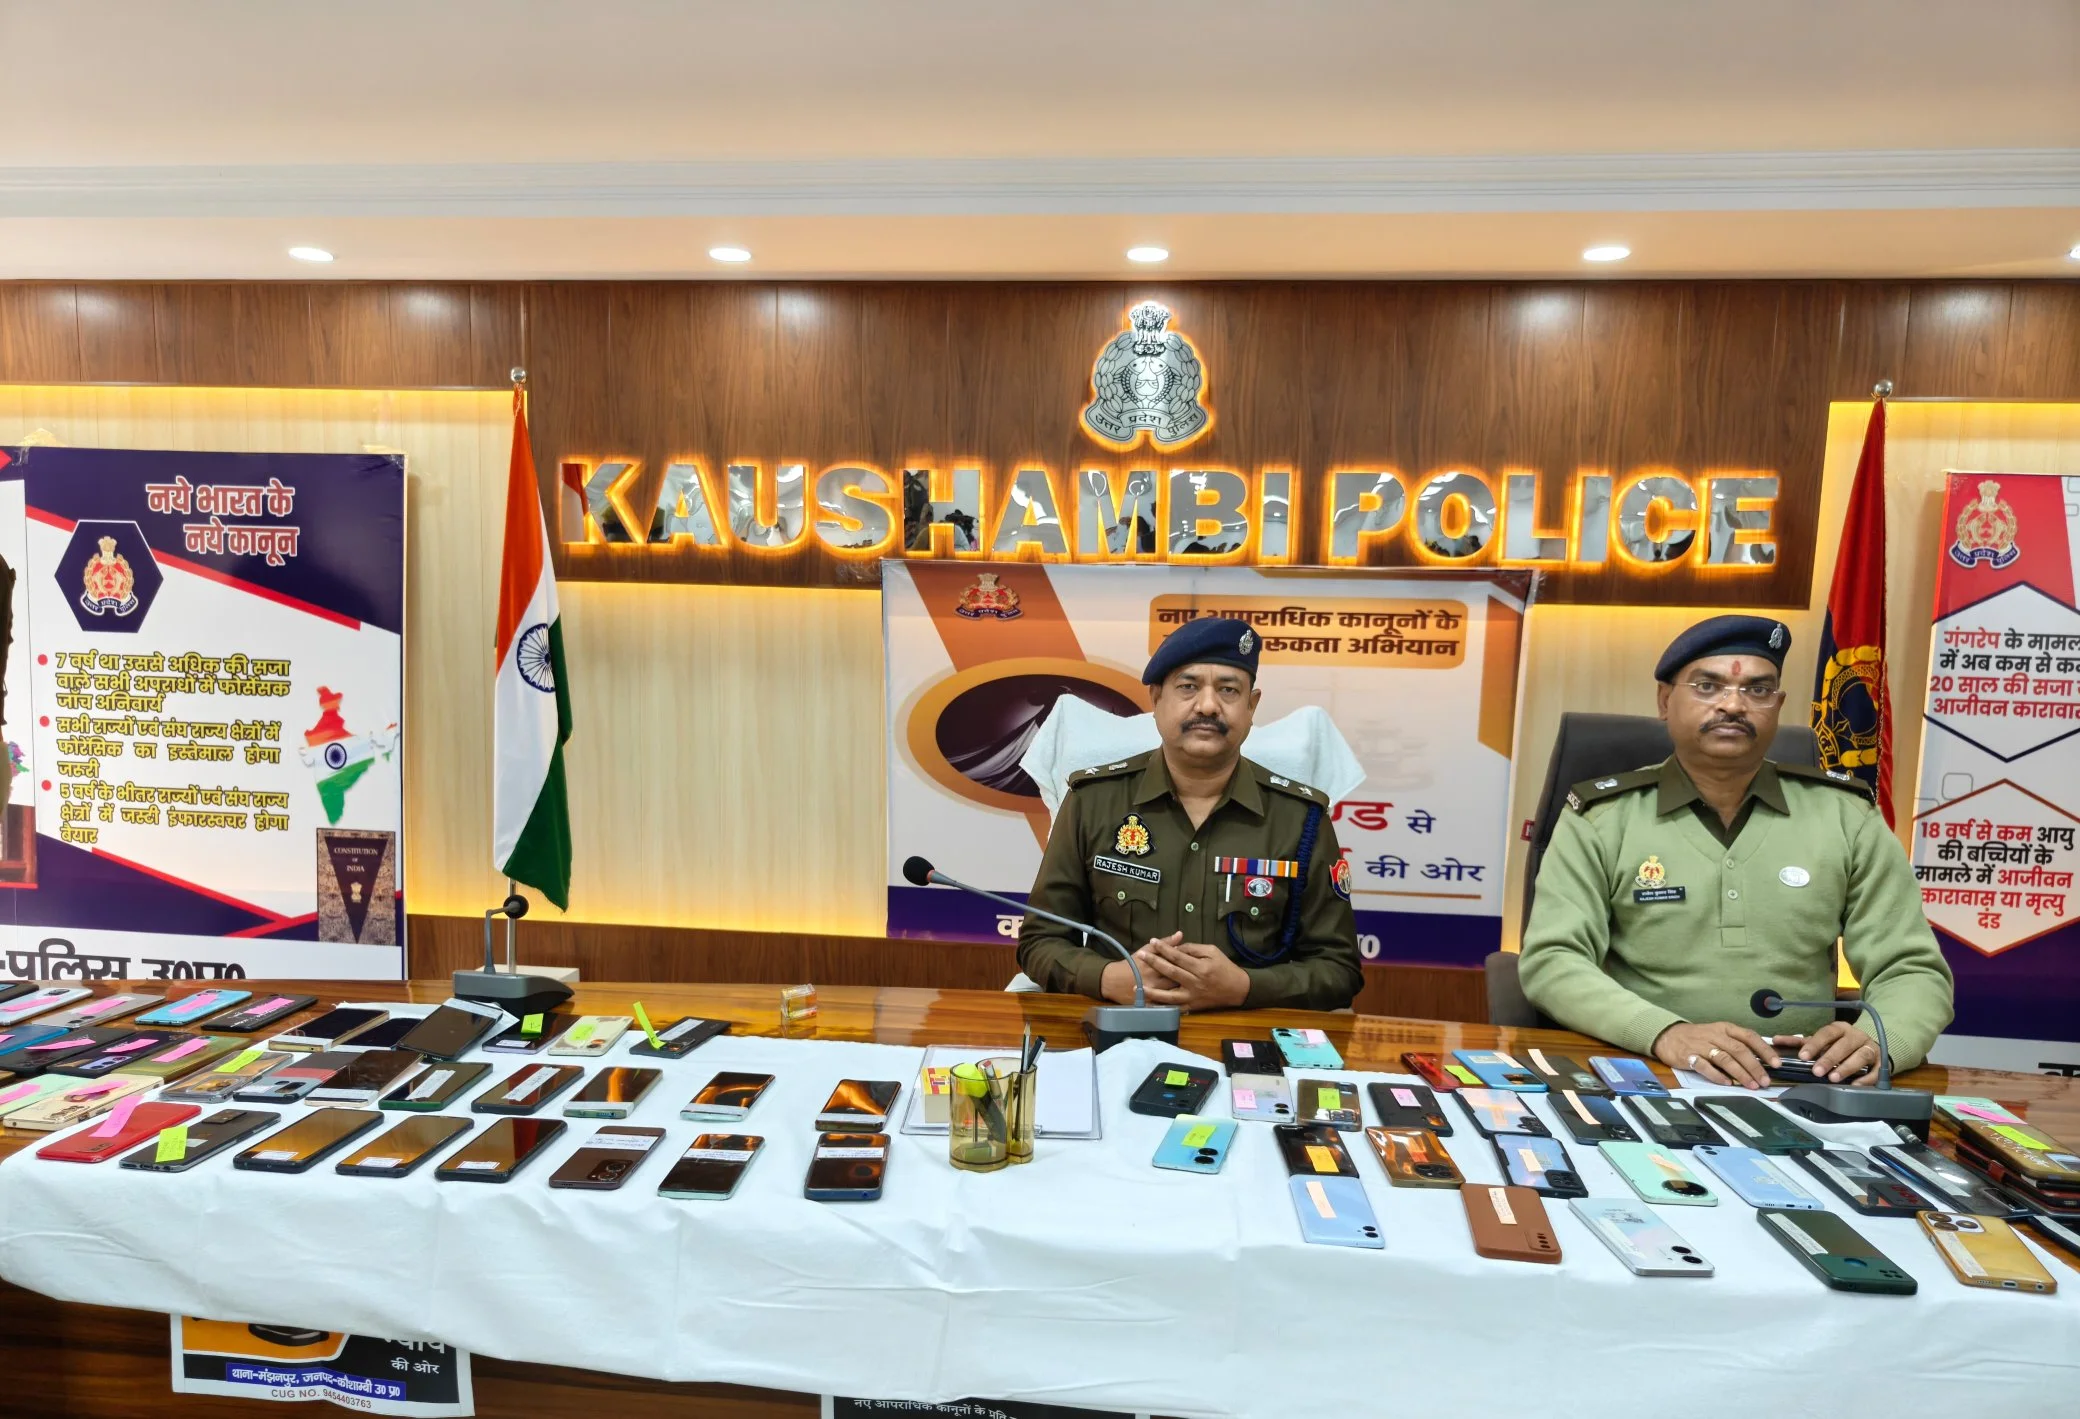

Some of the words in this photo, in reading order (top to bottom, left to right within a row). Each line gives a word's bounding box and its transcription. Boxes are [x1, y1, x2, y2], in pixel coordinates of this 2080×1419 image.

[1128, 411, 1161, 425] प्रदेश
[1167, 413, 1199, 438] पुलिस
[145, 475, 193, 514] नये
[196, 484, 265, 516] भारत
[265, 477, 295, 517] के
[560, 461, 1292, 558] KAUSHAMBI
[1331, 470, 1780, 567] POLICE
[183, 516, 225, 554] नये
[226, 525, 299, 566] कानून
[1336, 609, 1433, 635] कानूनों
[1433, 609, 1462, 631] के
[1347, 634, 1460, 657] अभियान
[1943, 626, 2001, 649] गंगरेप
[2004, 627, 2024, 650] के
[55, 652, 67, 669] 7
[69, 649, 98, 669] वर्ष
[99, 654, 121, 671] था
[122, 651, 165, 672] उससे
[168, 652, 221, 674] अधिक
[222, 653, 249, 675] की
[251, 659, 291, 676] सजा
[1939, 649, 1960, 670] में
[1961, 654, 1992, 671] अब
[1995, 655, 2032, 673] कम
[2035, 651, 2053, 673] से
[55, 669, 92, 689] वाले
[93, 670, 131, 692] सभी
[134, 672, 198, 693] अपराधों
[199, 673, 218, 694] में
[1930, 676, 1954, 692] 20
[1958, 676, 2000, 693] साल
[2003, 672, 2029, 695] की
[2032, 678, 2074, 696] सजा
[95, 690, 166, 713] अनिवार्य
[1933, 693, 2010, 717] आजीवन
[56, 713, 91, 733] सभी
[92, 715, 136, 736] राज्यों
[137, 716, 160, 737] एवं
[161, 717, 189, 738] संघ
[190, 722, 228, 739] राज्य
[230, 719, 264, 741] क्षेत्रों
[264, 720, 282, 741] में
[133, 742, 157, 758] का
[167, 740, 234, 761] इस्तेमाल
[244, 742, 281, 764] होगा
[60, 783, 70, 799] 5
[72, 779, 98, 800] वर्ष
[98, 780, 114, 800] के
[116, 781, 156, 803] भीतर
[157, 784, 200, 805] राज्यों
[200, 785, 223, 806] एवं
[224, 786, 251, 807] संघ
[251, 791, 289, 809] राज्य
[60, 801, 92, 821] क्षेत्रों
[98, 802, 115, 823] में
[253, 809, 290, 832] होगा
[1405, 809, 1436, 834] से
[1921, 822, 1940, 838] 18
[1945, 818, 1976, 840] वर्ष
[1976, 820, 1993, 841] से
[1996, 825, 2033, 842] कम
[2037, 826, 2075, 851] आयु
[1938, 839, 1964, 862] की
[1967, 841, 2033, 865] बच्चियों
[2034, 843, 2054, 866] के
[1096, 858, 1128, 873] RAJESH
[1129, 867, 1158, 880] KUMAR
[1365, 855, 1410, 879] की
[1420, 857, 1486, 882] ओर
[1914, 862, 1972, 883] मामले
[1976, 863, 1996, 885] में
[1998, 865, 2074, 889] आजीवन
[1921, 887, 1997, 907] कारावास
[1999, 891, 2022, 908] या
[2025, 892, 2065, 917] मृत्यु
[1978, 908, 2002, 929] दंड
[390, 1356, 409, 1371] की
[413, 1359, 440, 1374] ओर
[271, 1388, 295, 1398] CUG
[299, 1388, 320, 1397] NO.
[322, 1388, 372, 1409] 9454403763
[974, 1404, 986, 1415] के
